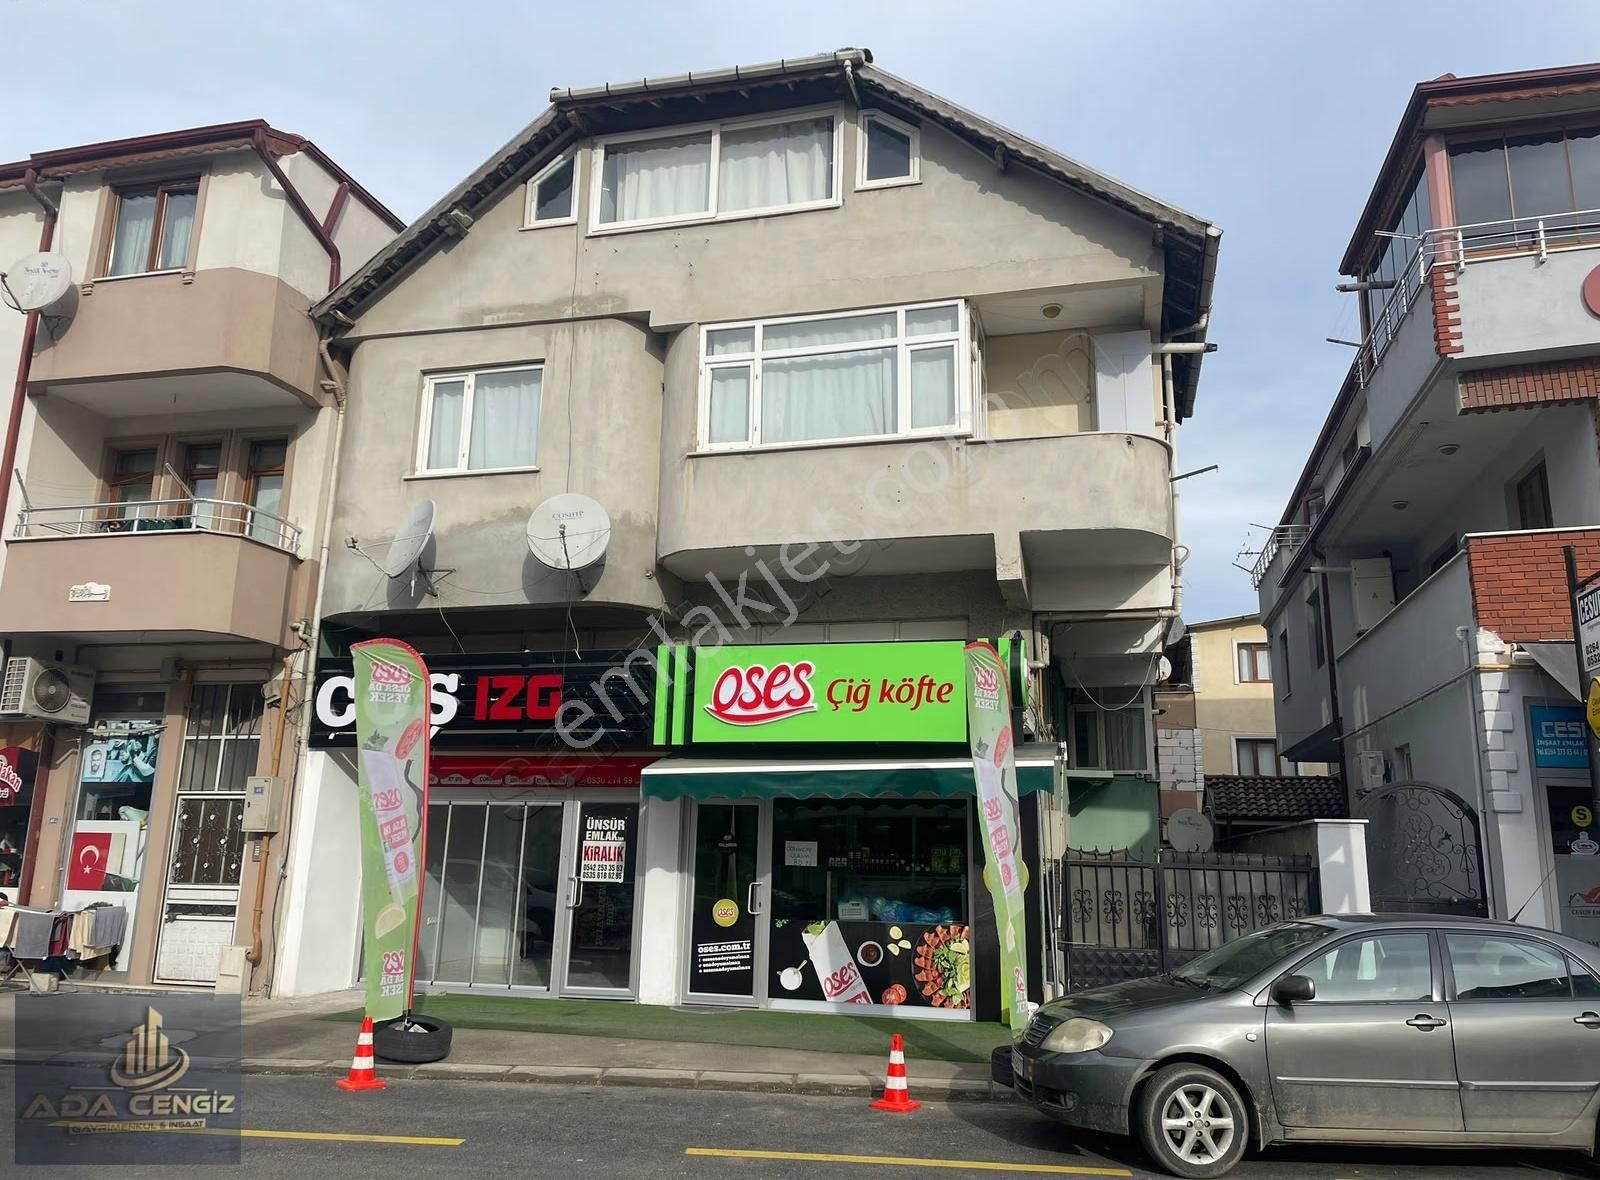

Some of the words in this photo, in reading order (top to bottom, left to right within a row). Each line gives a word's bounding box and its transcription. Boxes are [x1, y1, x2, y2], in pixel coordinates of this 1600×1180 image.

[1580, 592, 1600, 623] CESU
[827, 678, 872, 712] Çiğ
[879, 674, 955, 711] köfte
[1541, 721, 1587, 738] CES
[586, 816, 625, 831] ÜNSÜR
[698, 942, 751, 953] oses.com.tr
